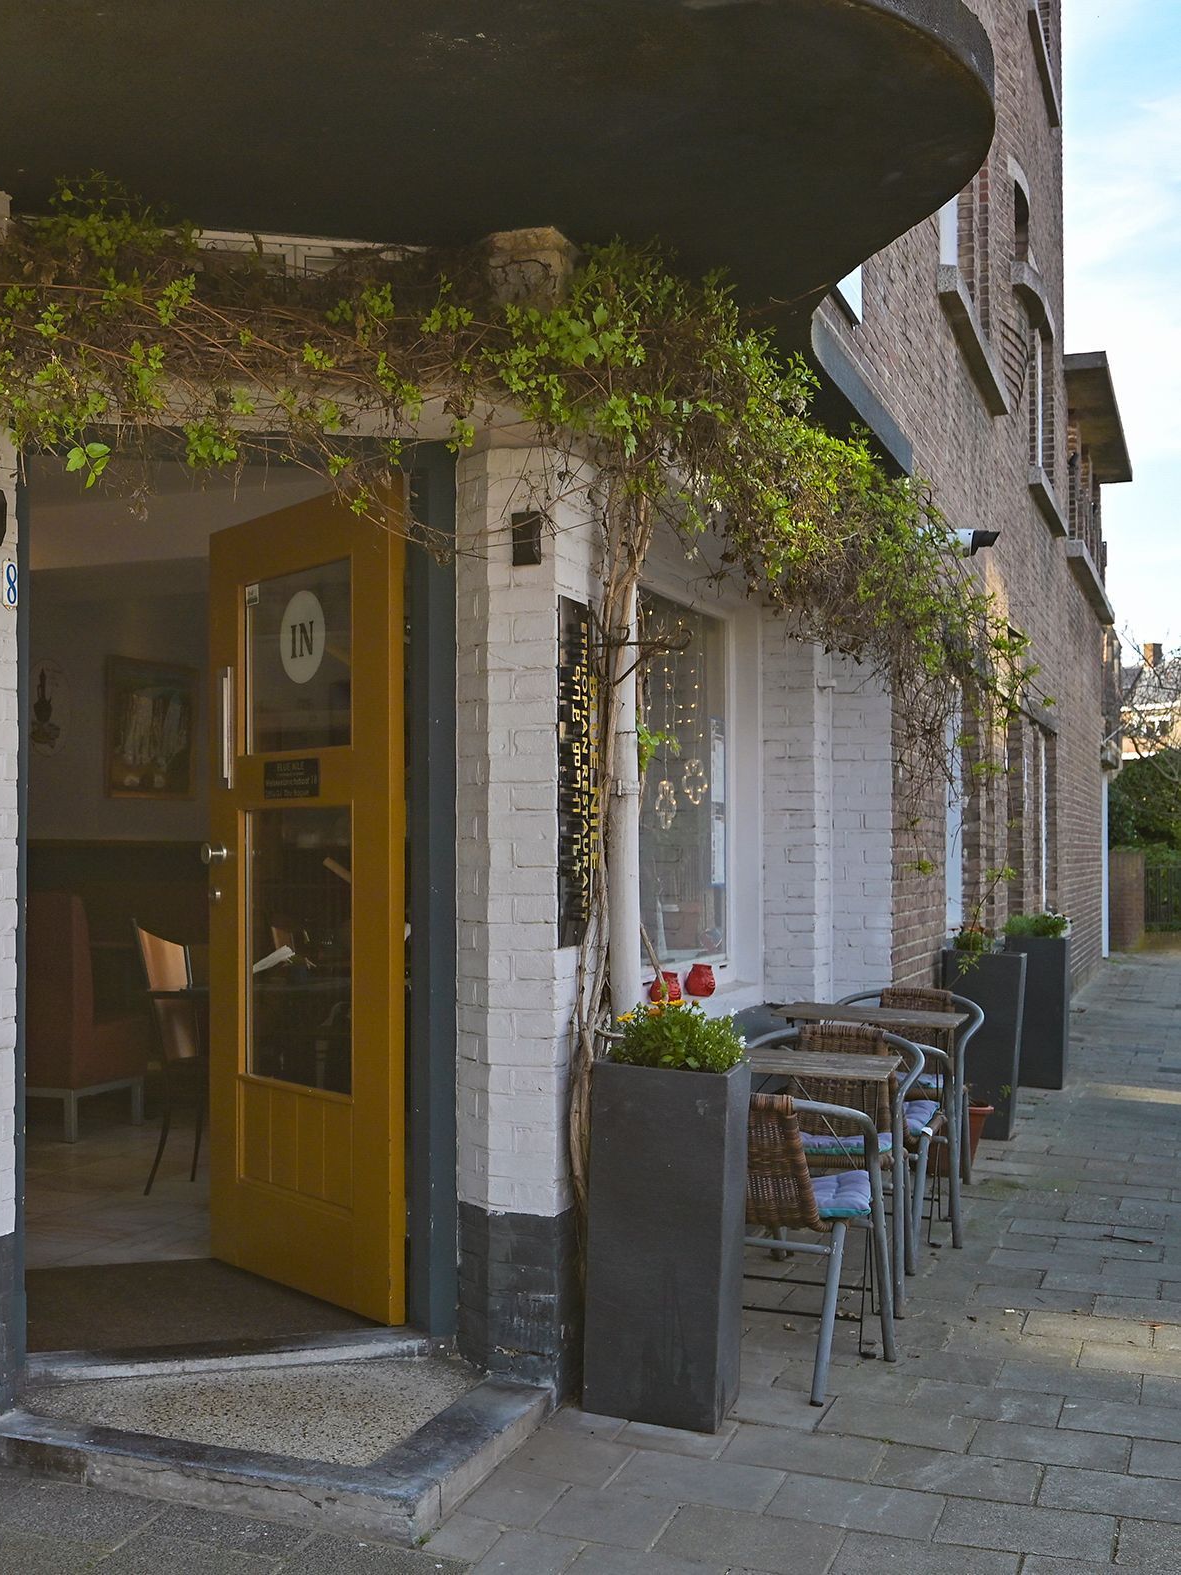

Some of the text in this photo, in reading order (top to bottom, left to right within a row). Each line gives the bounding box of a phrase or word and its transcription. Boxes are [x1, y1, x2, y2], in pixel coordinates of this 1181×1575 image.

[290, 620, 314, 660] IN
[580, 622, 590, 922] ETHIOPIAN RESTAURANT
[589, 786, 601, 870] NILE
